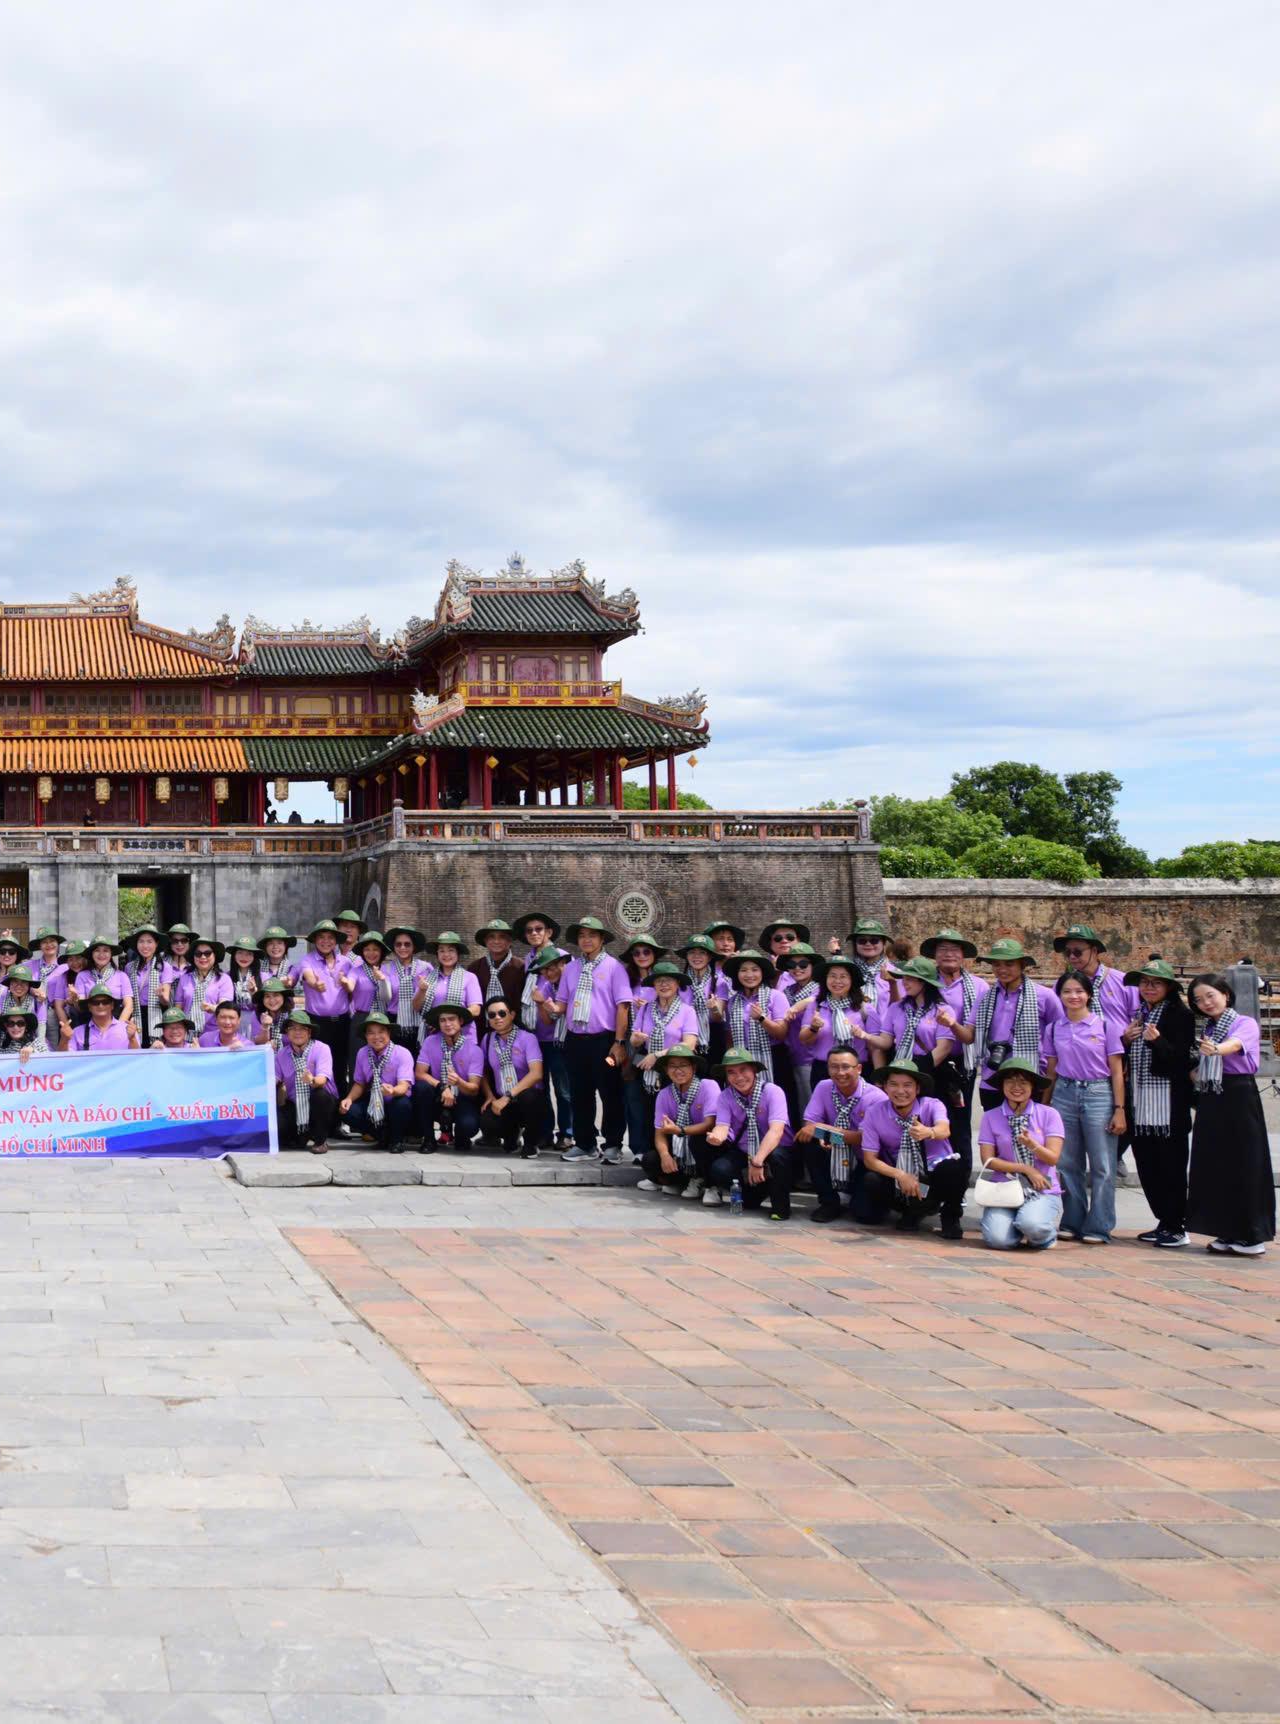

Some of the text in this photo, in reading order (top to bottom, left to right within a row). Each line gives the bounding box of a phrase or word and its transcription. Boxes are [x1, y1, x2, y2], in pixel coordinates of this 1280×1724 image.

[17, 1104, 53, 1128] VẬN
[57, 1104, 80, 1124] VÀ
[84, 1103, 118, 1123] BÁO
[121, 1101, 153, 1122] CHÍ
[167, 1100, 213, 1121] XUẤT
[218, 1098, 256, 1120] BẢN
[22, 1133, 54, 1154] CHÍ
[55, 1136, 107, 1154] MINH
